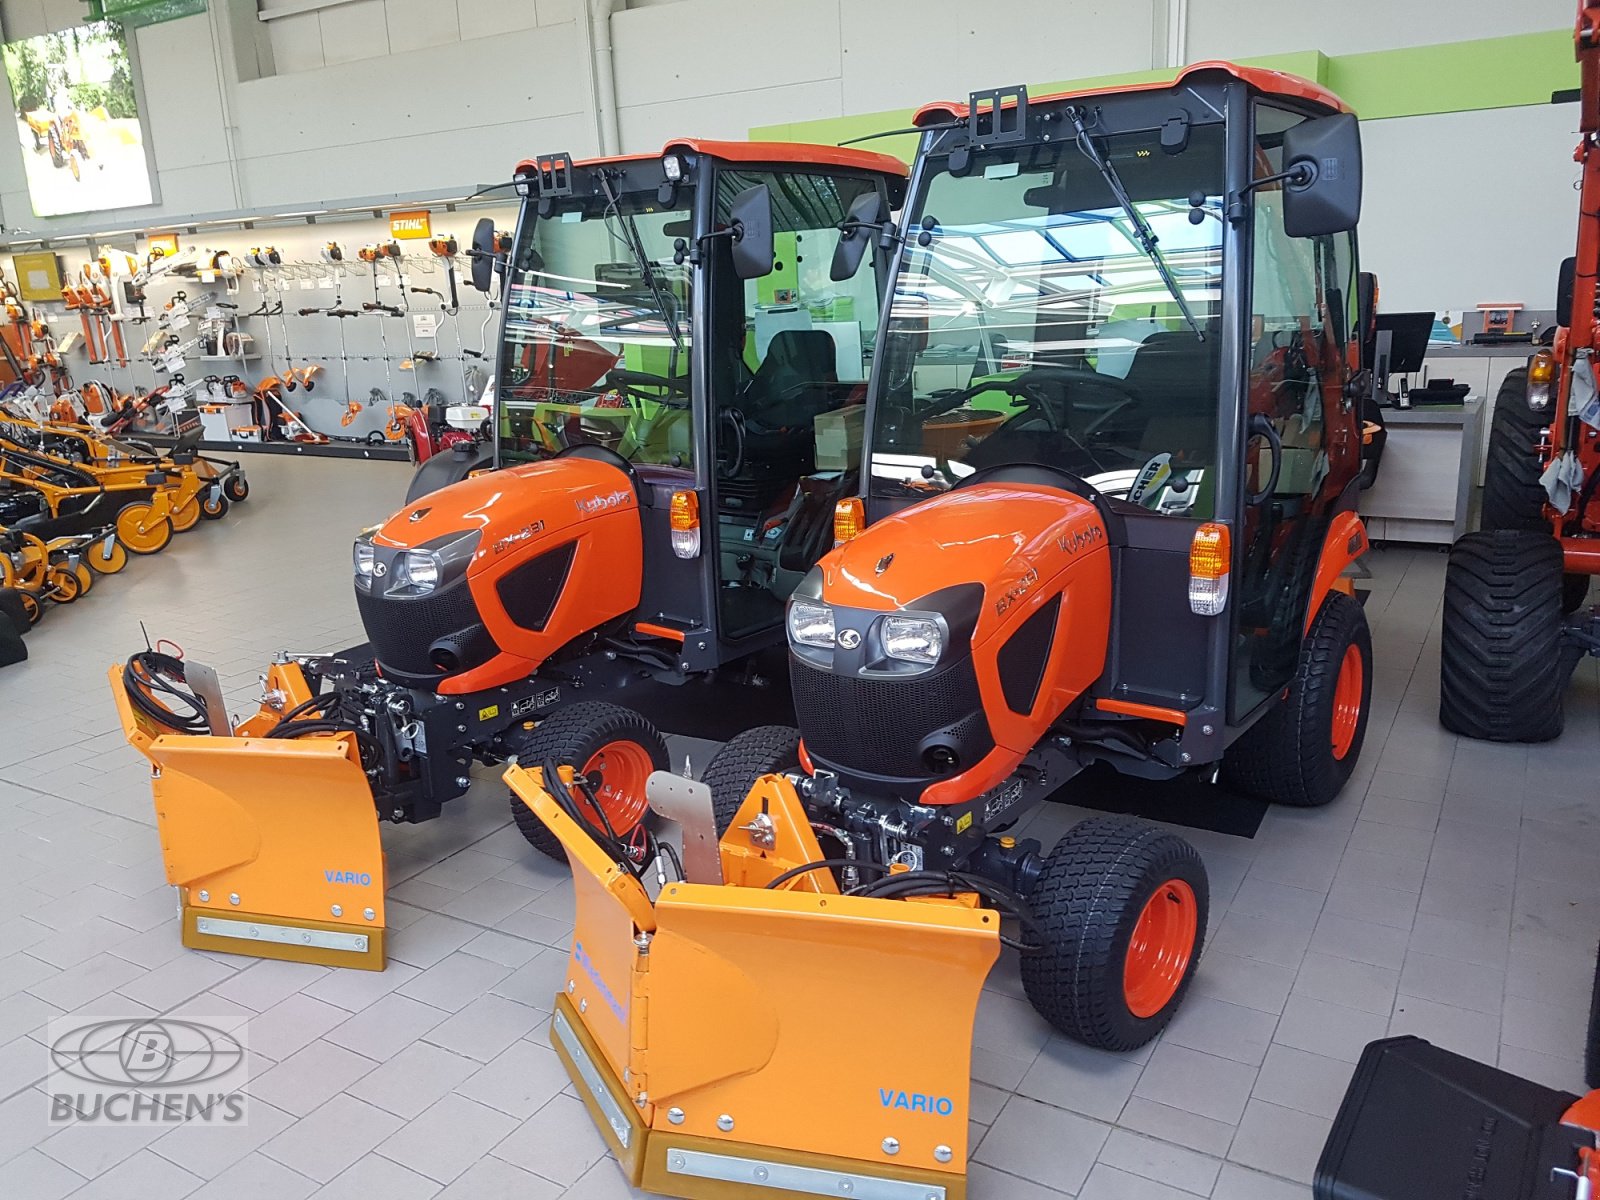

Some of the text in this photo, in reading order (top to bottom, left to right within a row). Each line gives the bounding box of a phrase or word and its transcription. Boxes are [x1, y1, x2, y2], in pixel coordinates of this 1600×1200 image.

[393, 218, 423, 231] STIHL
[574, 490, 631, 513] Kubota
[1056, 523, 1103, 555] Kubota
[323, 869, 372, 887] VARIO
[879, 1087, 954, 1117] VARIO
